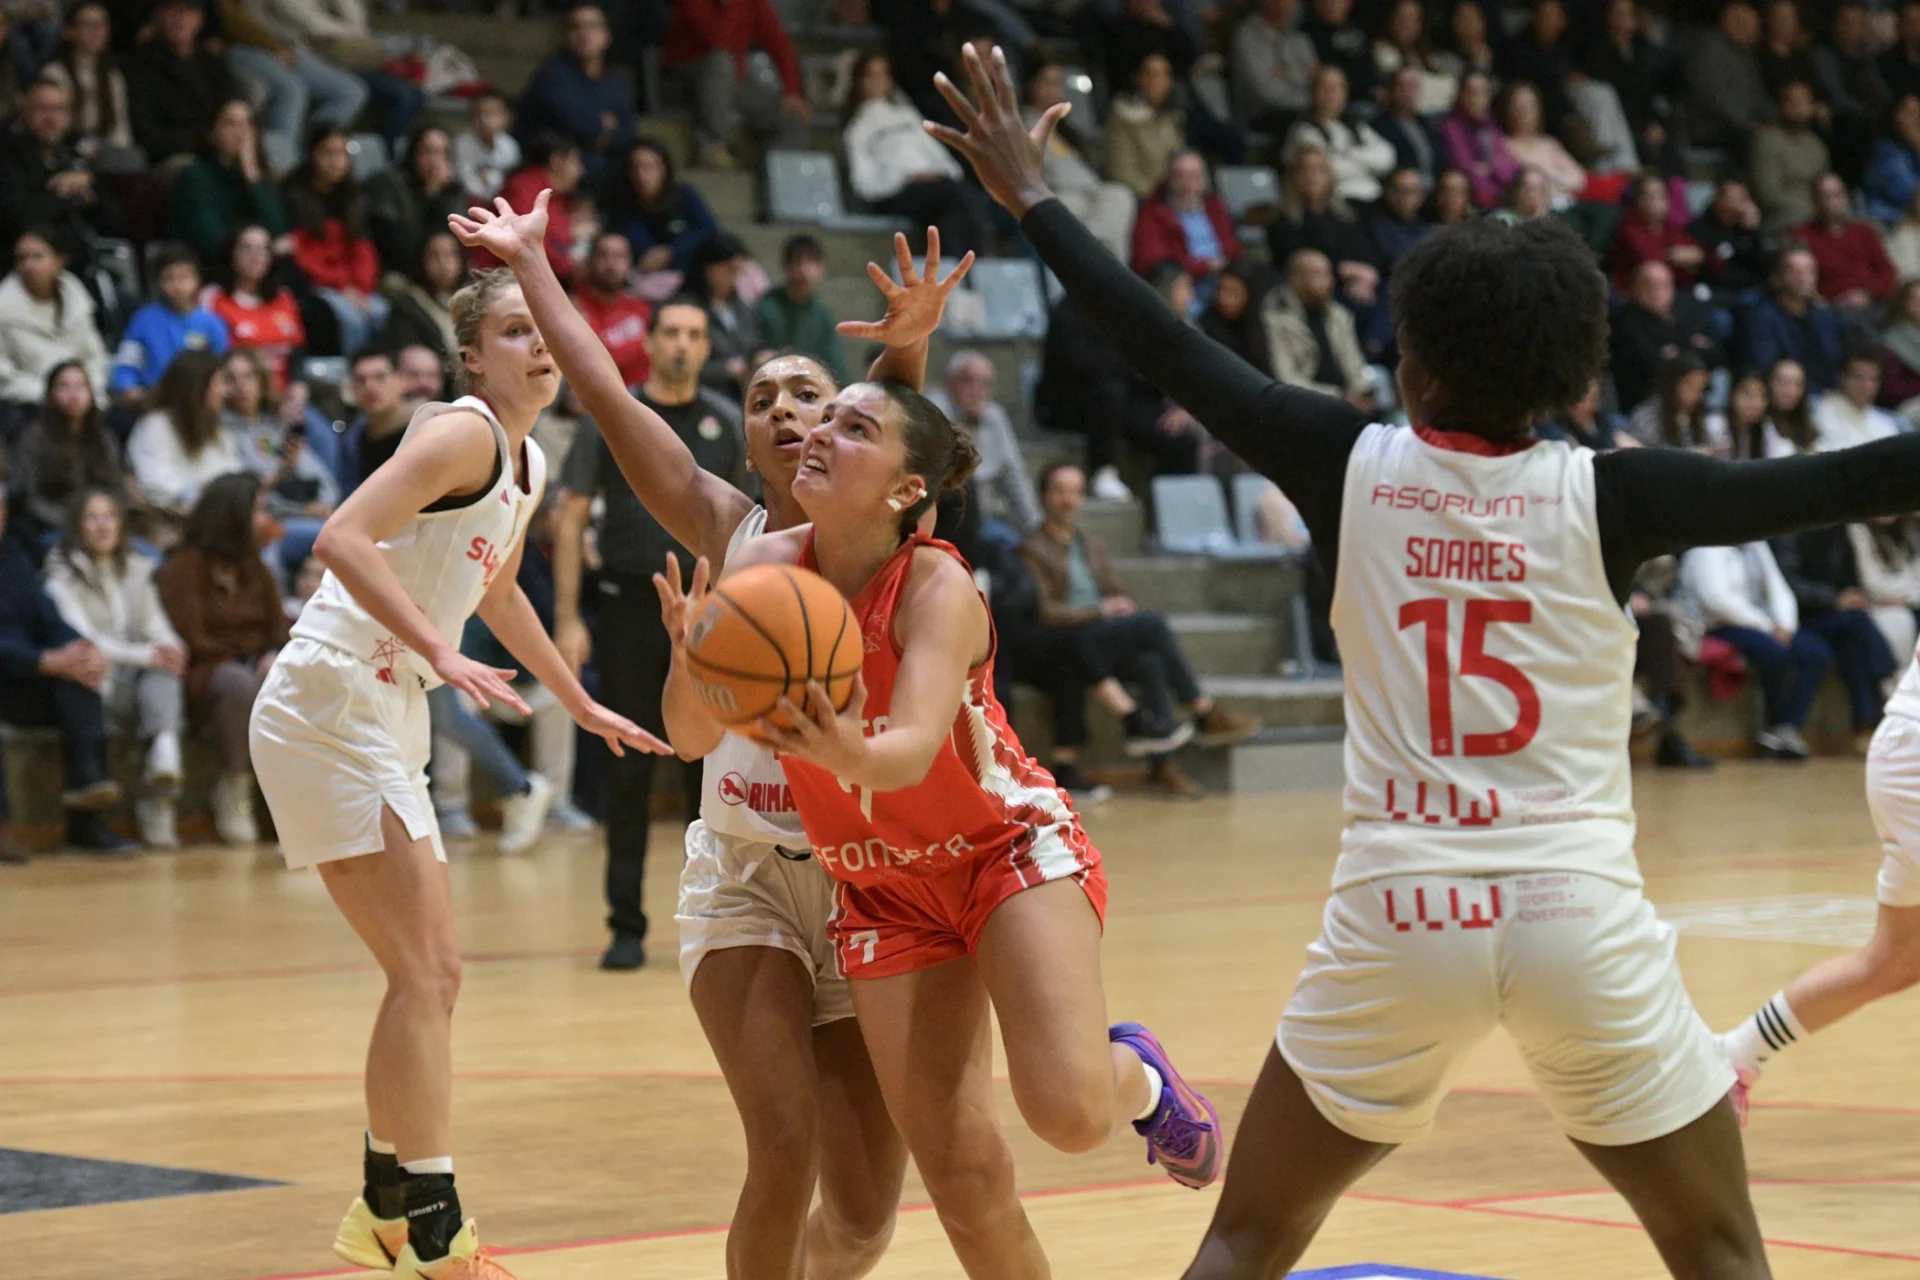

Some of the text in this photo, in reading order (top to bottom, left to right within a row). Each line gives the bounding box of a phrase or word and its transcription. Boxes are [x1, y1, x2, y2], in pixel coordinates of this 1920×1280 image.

[1405, 536, 1526, 583] SOARES
[1398, 597, 1542, 758] 15
[848, 929, 880, 965] 7
